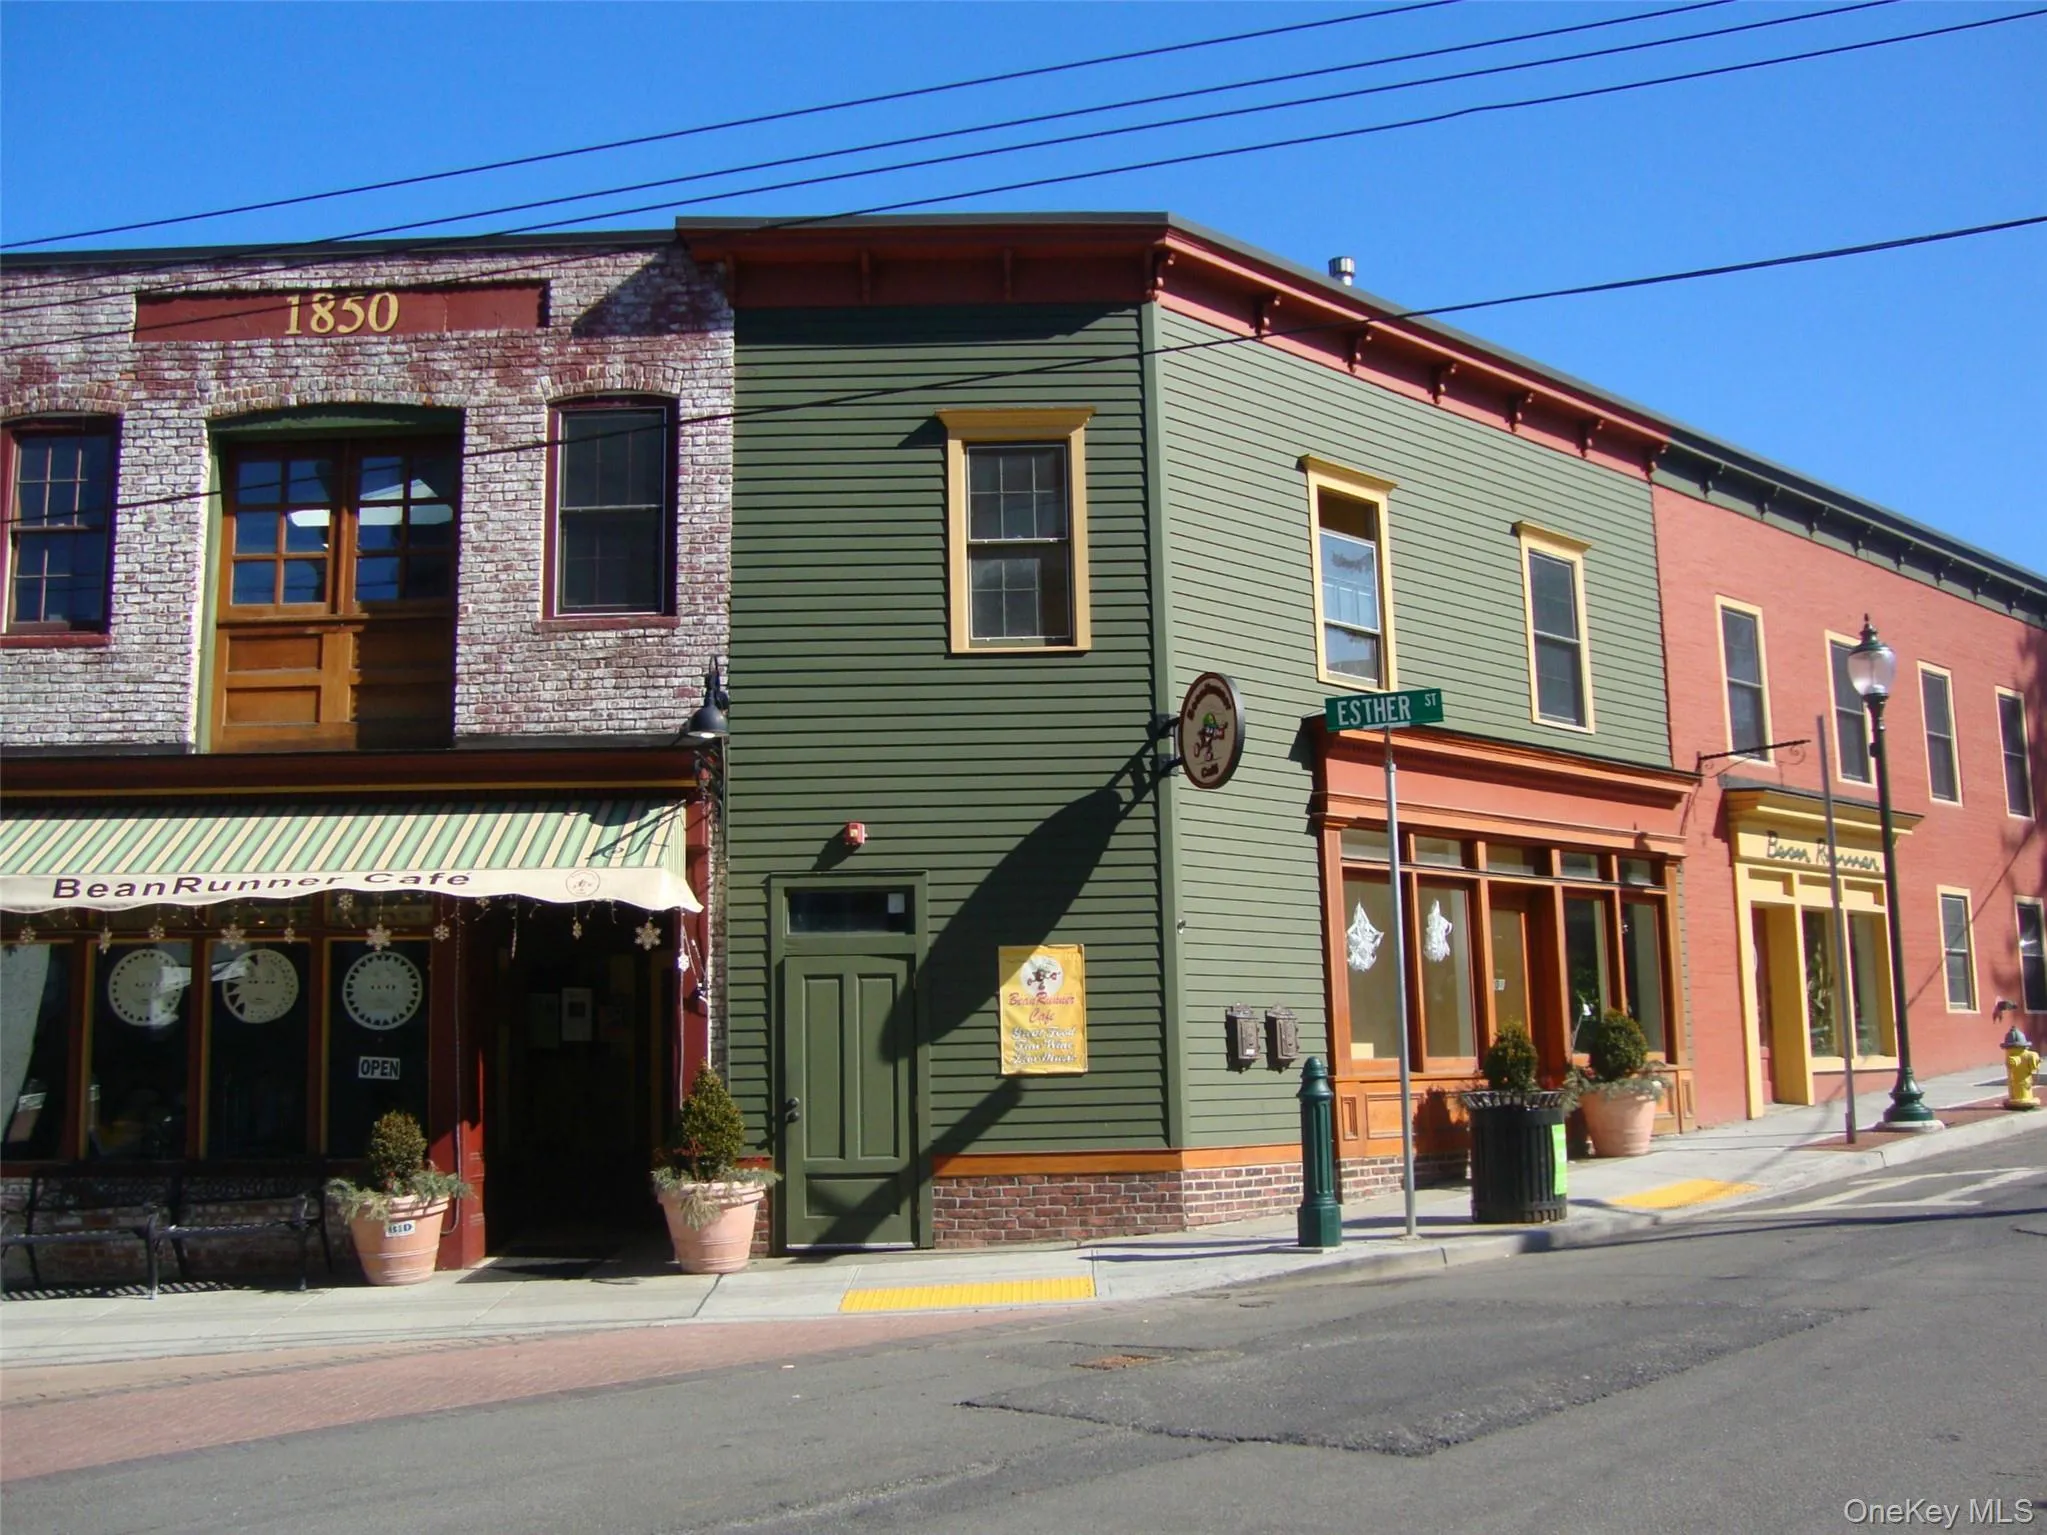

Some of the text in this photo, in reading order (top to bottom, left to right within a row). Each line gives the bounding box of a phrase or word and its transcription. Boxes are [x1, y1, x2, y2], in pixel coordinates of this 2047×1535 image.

[285, 292, 399, 335] 1850
[1337, 693, 1437, 726] ESTHER ST
[364, 872, 472, 886] Café
[361, 1060, 399, 1077] OPEN
